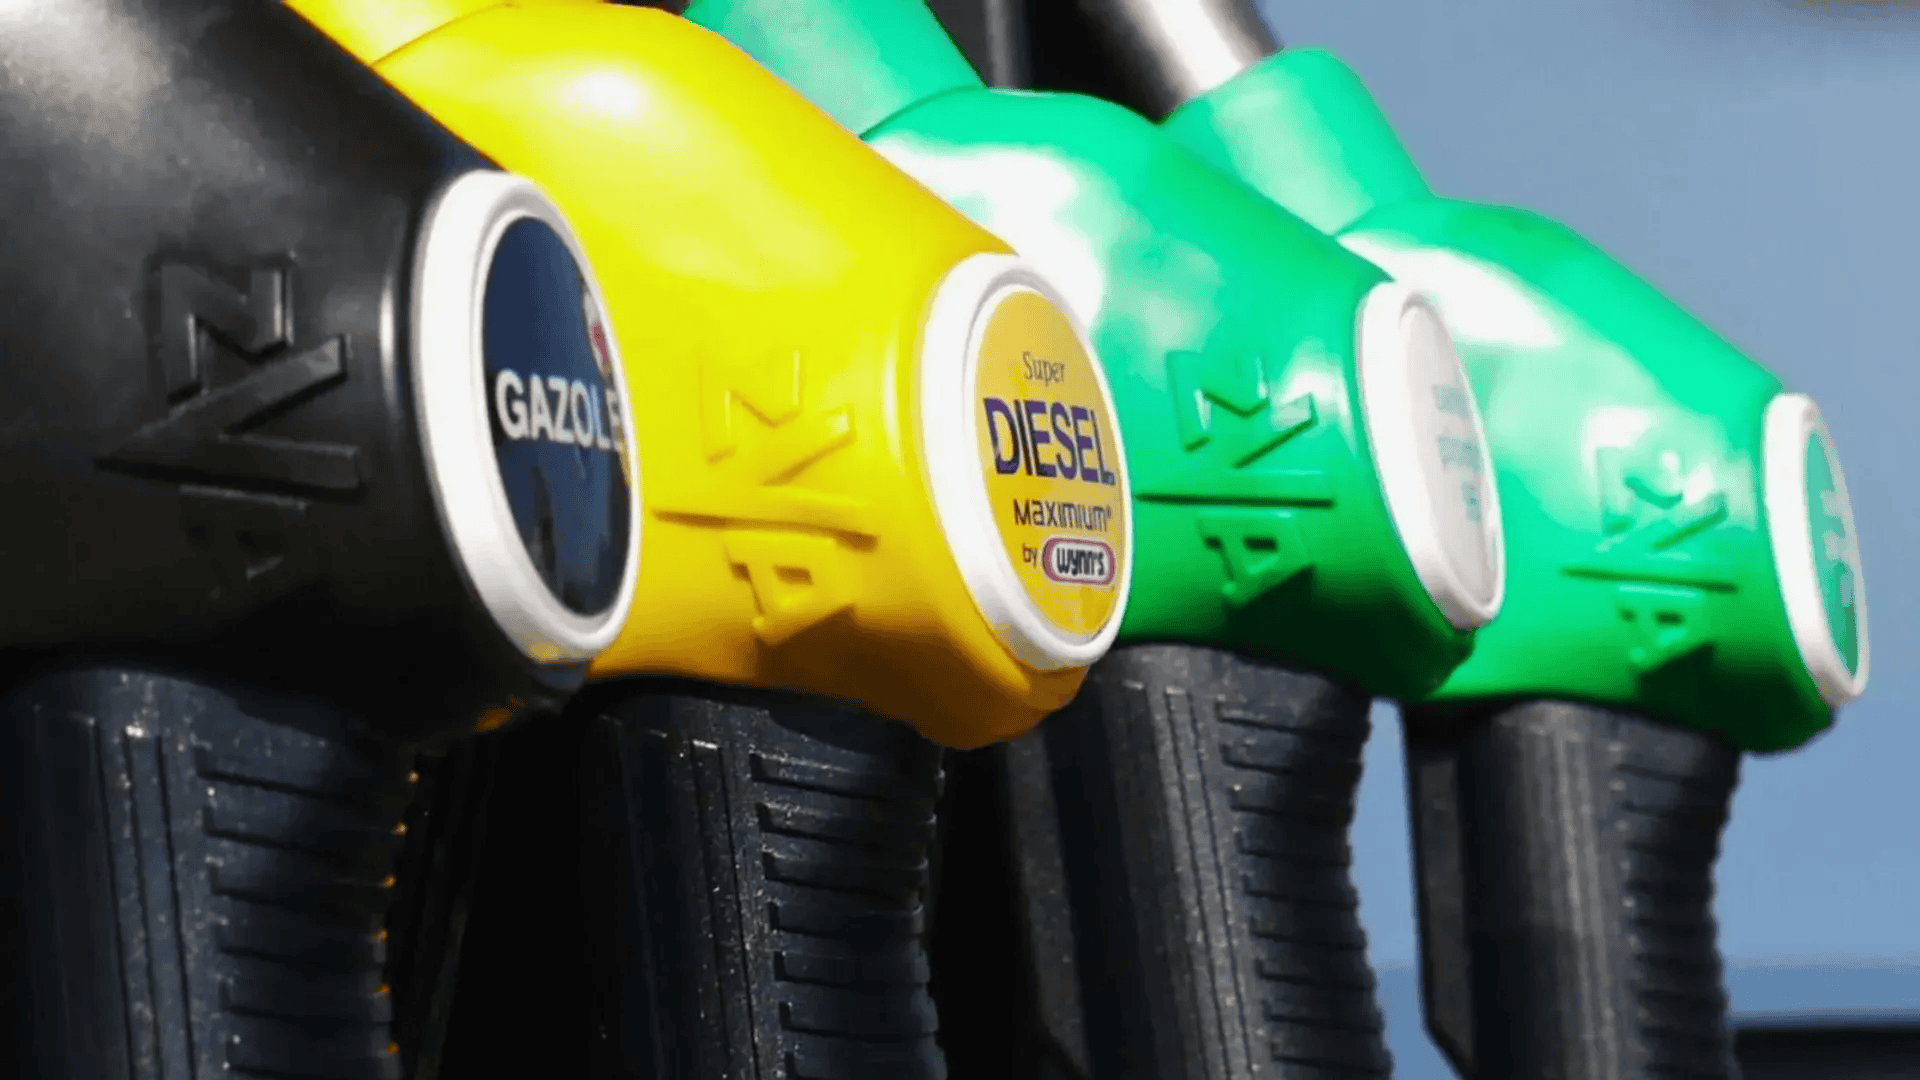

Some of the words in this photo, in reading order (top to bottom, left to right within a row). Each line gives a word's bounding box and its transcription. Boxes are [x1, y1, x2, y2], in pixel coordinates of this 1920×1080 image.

[1022, 351, 1066, 385] Super
[983, 397, 1117, 487] DIESEL
[1022, 543, 1038, 568] by
